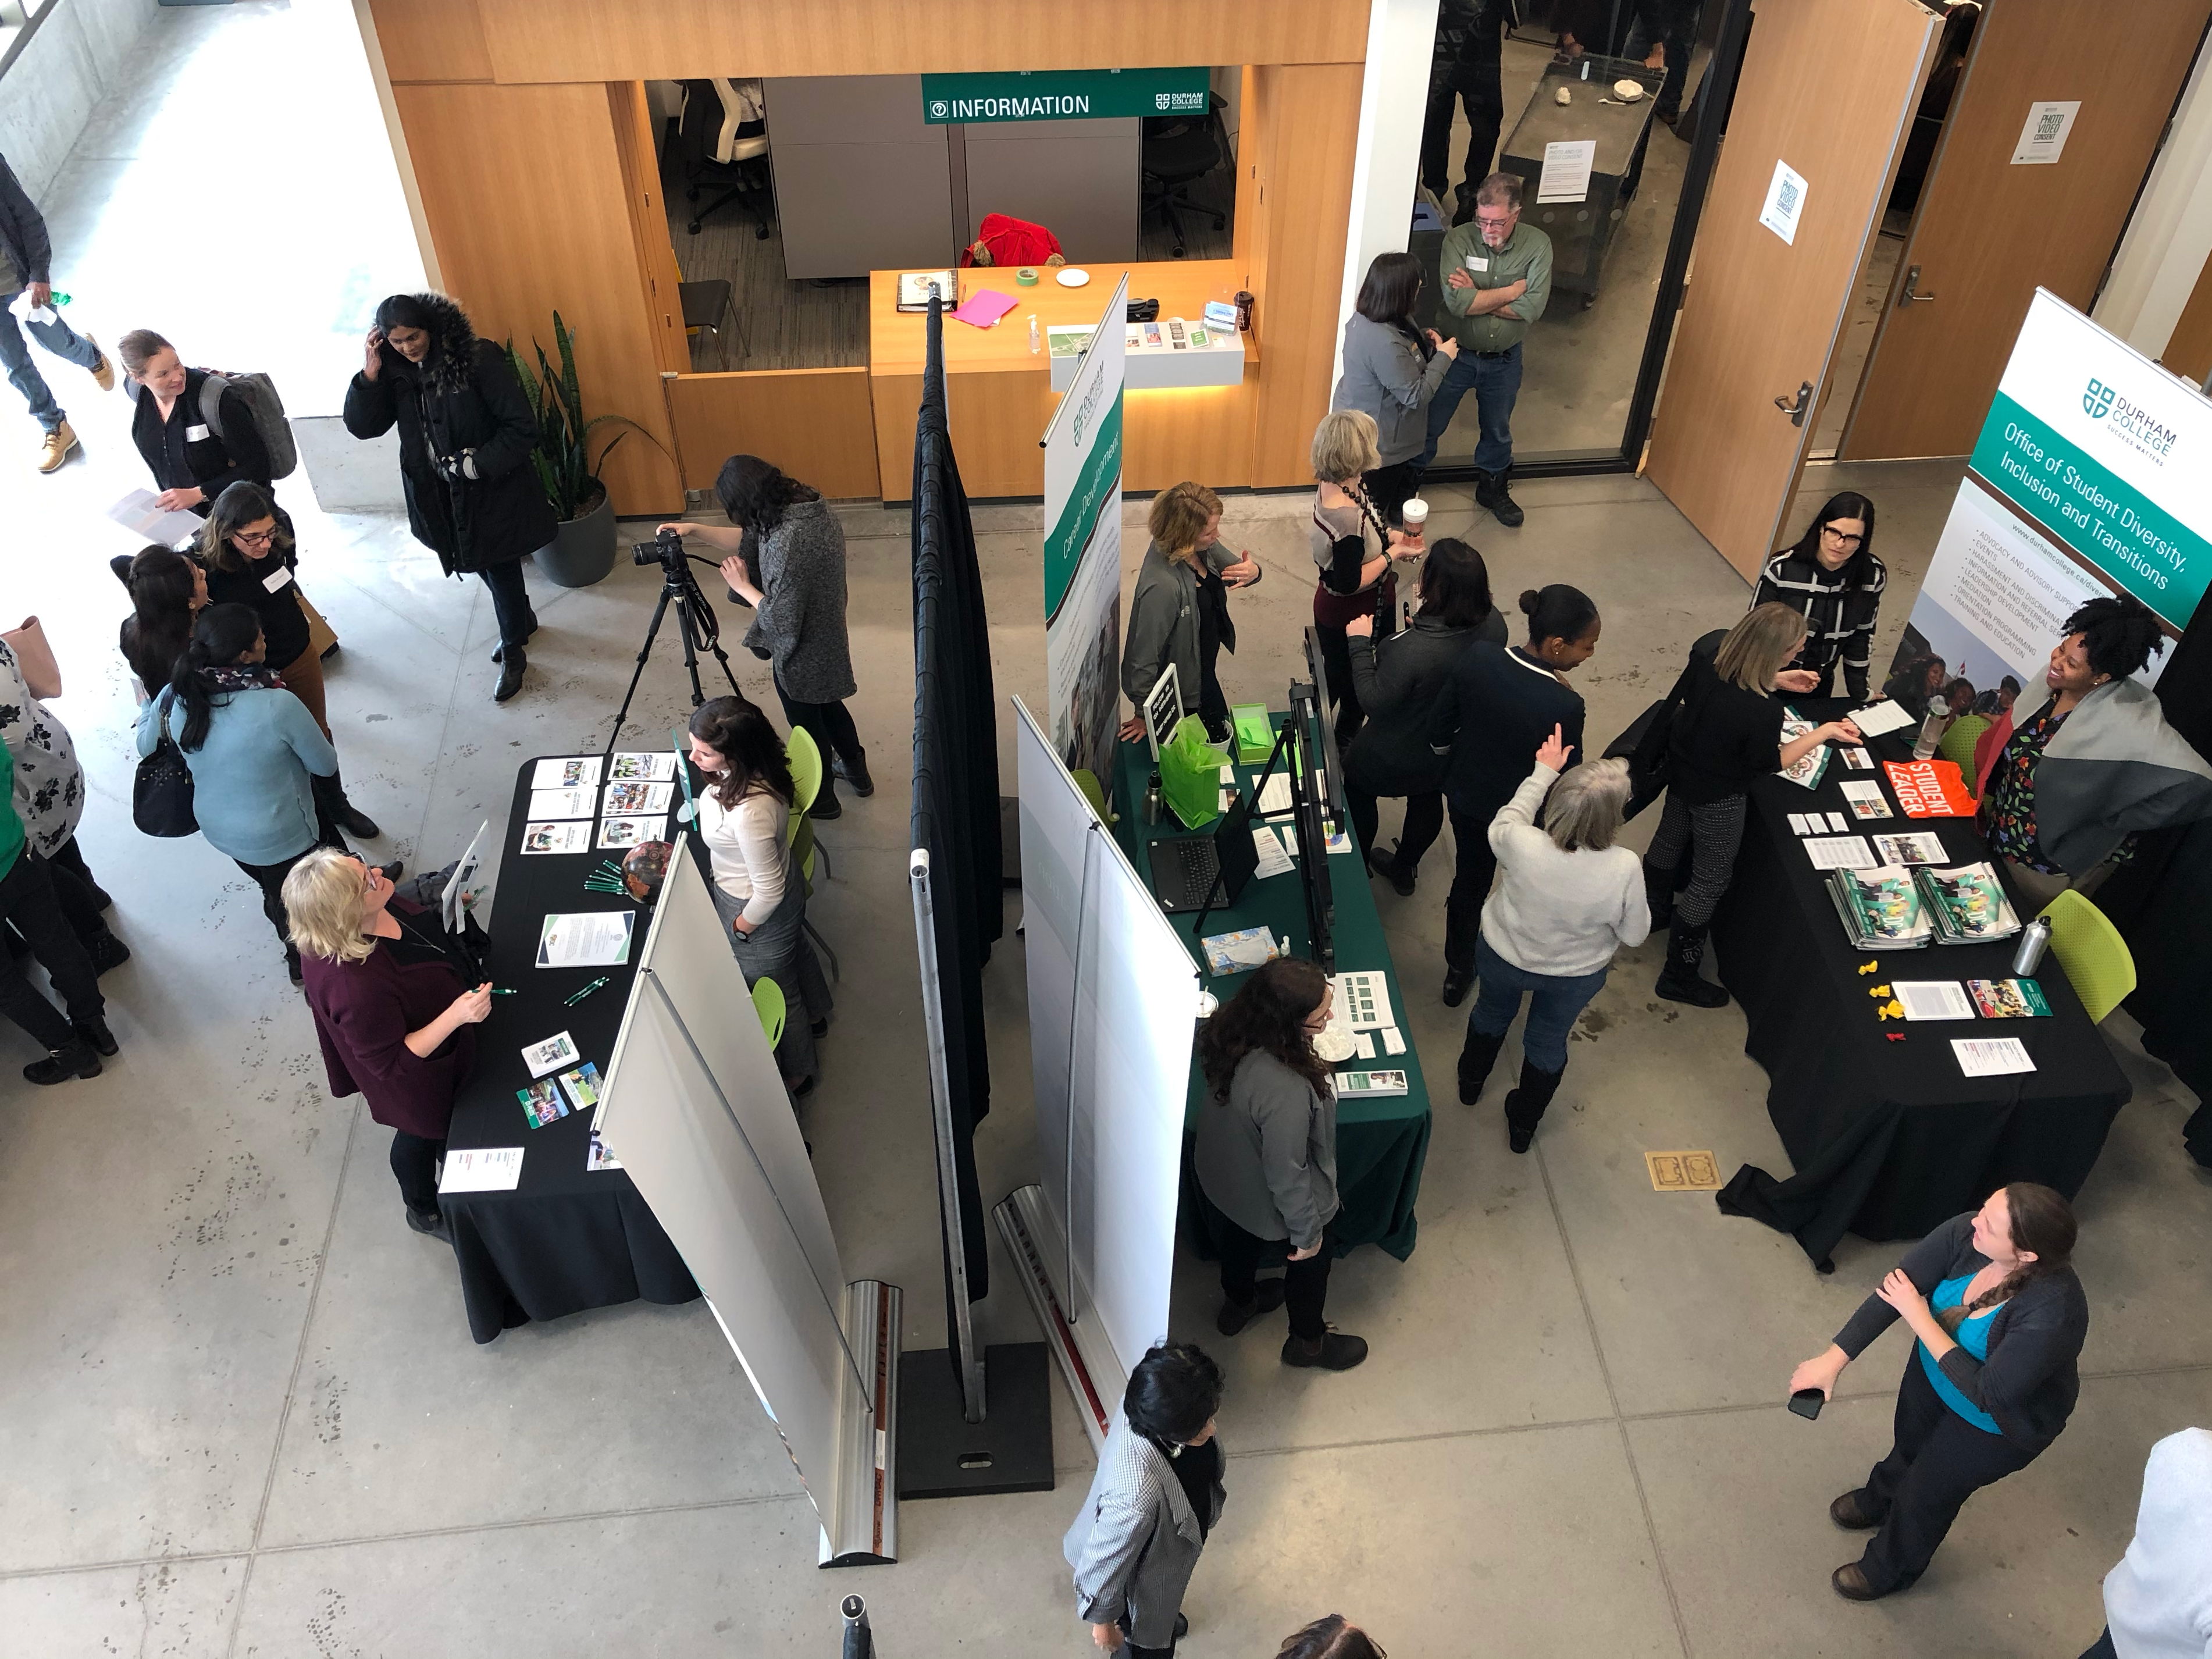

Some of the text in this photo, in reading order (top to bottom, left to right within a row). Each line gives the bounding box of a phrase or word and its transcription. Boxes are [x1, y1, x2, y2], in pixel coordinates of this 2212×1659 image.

[953, 95, 1089, 118] INFORMATION
[2038, 124, 2060, 133] VIDEO
[2040, 115, 2065, 124] PHOTO
[1777, 199, 1793, 215] CONSENT
[1780, 188, 1796, 208] VIDEO
[1783, 179, 1798, 200] PHOTO
[1083, 359, 1105, 408] DURHAM
[2107, 424, 2164, 467] SUCCESS MATTERS
[2113, 410, 2171, 457] COLLEGE
[2117, 397, 2177, 446] DURHAM
[1063, 510, 1083, 560] Career
[1082, 431, 1119, 517] Development
[2004, 422, 2187, 573] Office of Student Diversity,
[2000, 451, 2169, 590] Inclusion and Transitions
[1975, 540, 1999, 561] EVENTS
[1979, 530, 2080, 614] ADVOCACY AND ADVISORY SUPPOR
[2012, 524, 2110, 597] www.durhamcollege.ca/divers
[1960, 577, 1992, 606] MEDIATION
[1964, 567, 2039, 632] LEADERSHIP DEVELOPMENT
[1968, 558, 2066, 641] INFORMATION AND REFERRAL SERV
[1972, 549, 2066, 629] HARASSMENT AND DISCRIMINAT
[1953, 594, 2025, 659] TRAINING AND EDUCATION
[1957, 586, 2037, 657] ORIENTATION PROGRAMMING
[1152, 692, 1164, 711] FOLLOW
[1153, 711, 1159, 720] ON
[1887, 764, 1926, 816] LEADER
[1909, 763, 1954, 814] STUDENT
[1882, 916, 1905, 928] DC
